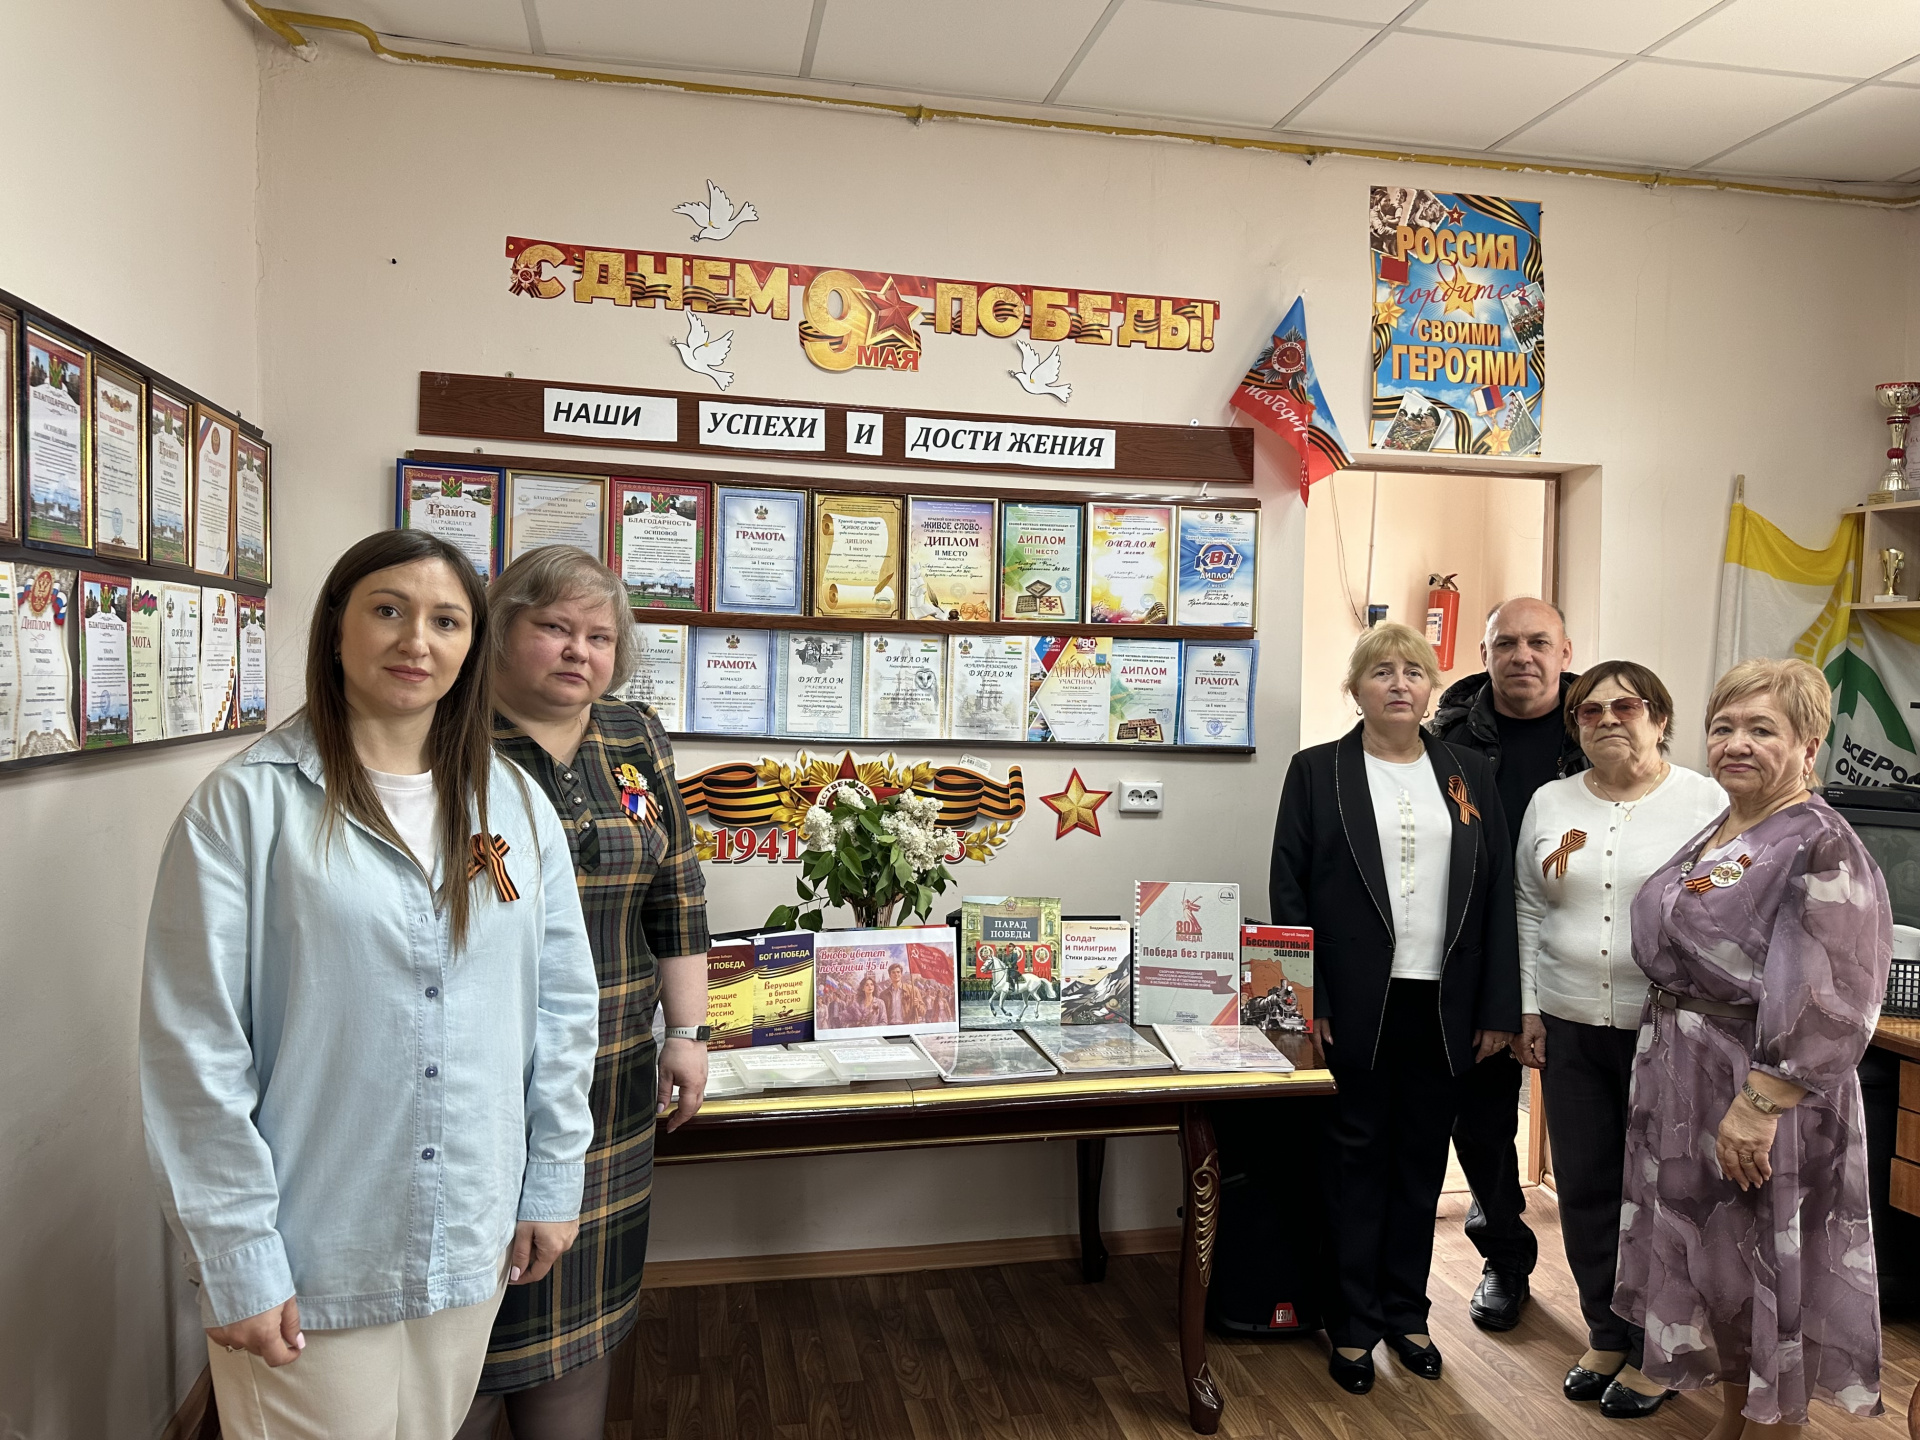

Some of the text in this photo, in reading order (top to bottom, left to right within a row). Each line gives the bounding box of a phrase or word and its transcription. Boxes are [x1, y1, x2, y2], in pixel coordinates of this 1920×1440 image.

[1396, 225, 1519, 271] РОССИЯ
[512, 244, 791, 321] С ДНЕМ
[1395, 259, 1535, 336] гордится
[800, 269, 871, 372] 9
[934, 281, 1215, 352] ПОБЕДЫ!
[1418, 318, 1501, 347] СВОИМИ
[857, 345, 920, 371] МАЯ
[1392, 344, 1528, 387] ГЕРОЯМИ
[552, 401, 643, 428] НАШИ
[706, 412, 819, 439] УСПЕХИ
[853, 423, 876, 445] И
[427, 503, 476, 518] Грамота
[628, 517, 692, 527] БЛАГОДАРНОСТЬ
[920, 521, 983, 531] «ЖИВОЕ СЛОВО»
[735, 530, 786, 542] ГРАМОТА
[923, 535, 979, 548] ДИПЛОМ
[1017, 535, 1066, 545] ДИПЛОМ
[1104, 539, 1157, 549] ДИПЛОМ
[1194, 550, 1241, 569] КВН
[1199, 572, 1235, 580] ДИПЛОМ
[88, 621, 125, 632] БЛАГОДАРНОСТЬ
[132, 636, 152, 649] МОТА
[1082, 638, 1096, 647] 80
[820, 642, 834, 655] 85
[707, 659, 758, 670] ГРАМОТА
[885, 655, 930, 664] ДИПЛОМ
[968, 669, 1013, 678] ДИПЛОМ
[1120, 665, 1167, 676] ДИПЛОМ
[797, 676, 844, 684] ДИПЛОМ
[1194, 676, 1240, 686] ГРАМОТА
[712, 828, 802, 862] 1941
[994, 920, 1028, 930] ПАРАД
[1176, 920, 1191, 933] 80
[990, 929, 1031, 939] ПОБЕДЫ
[1064, 933, 1096, 943] Солдат
[1175, 934, 1203, 943] ПОБЕДА!
[1245, 936, 1310, 950] Бессмертный
[1072, 943, 1117, 955] пилигрим
[1143, 946, 1234, 961] Победа без границ
[1273, 949, 1310, 959] эшелон
[758, 949, 810, 961] БОГ И ПОБЕДА
[819, 949, 886, 962] Вновь цветет
[1065, 954, 1083, 962] Стихи
[1083, 955, 1107, 963] разных
[713, 960, 746, 970] ПОБЕДА
[819, 964, 864, 975] победный
[764, 980, 803, 990] Верующие
[707, 992, 738, 1001] рующие
[774, 989, 799, 997] битвах
[774, 997, 801, 1005] Россию
